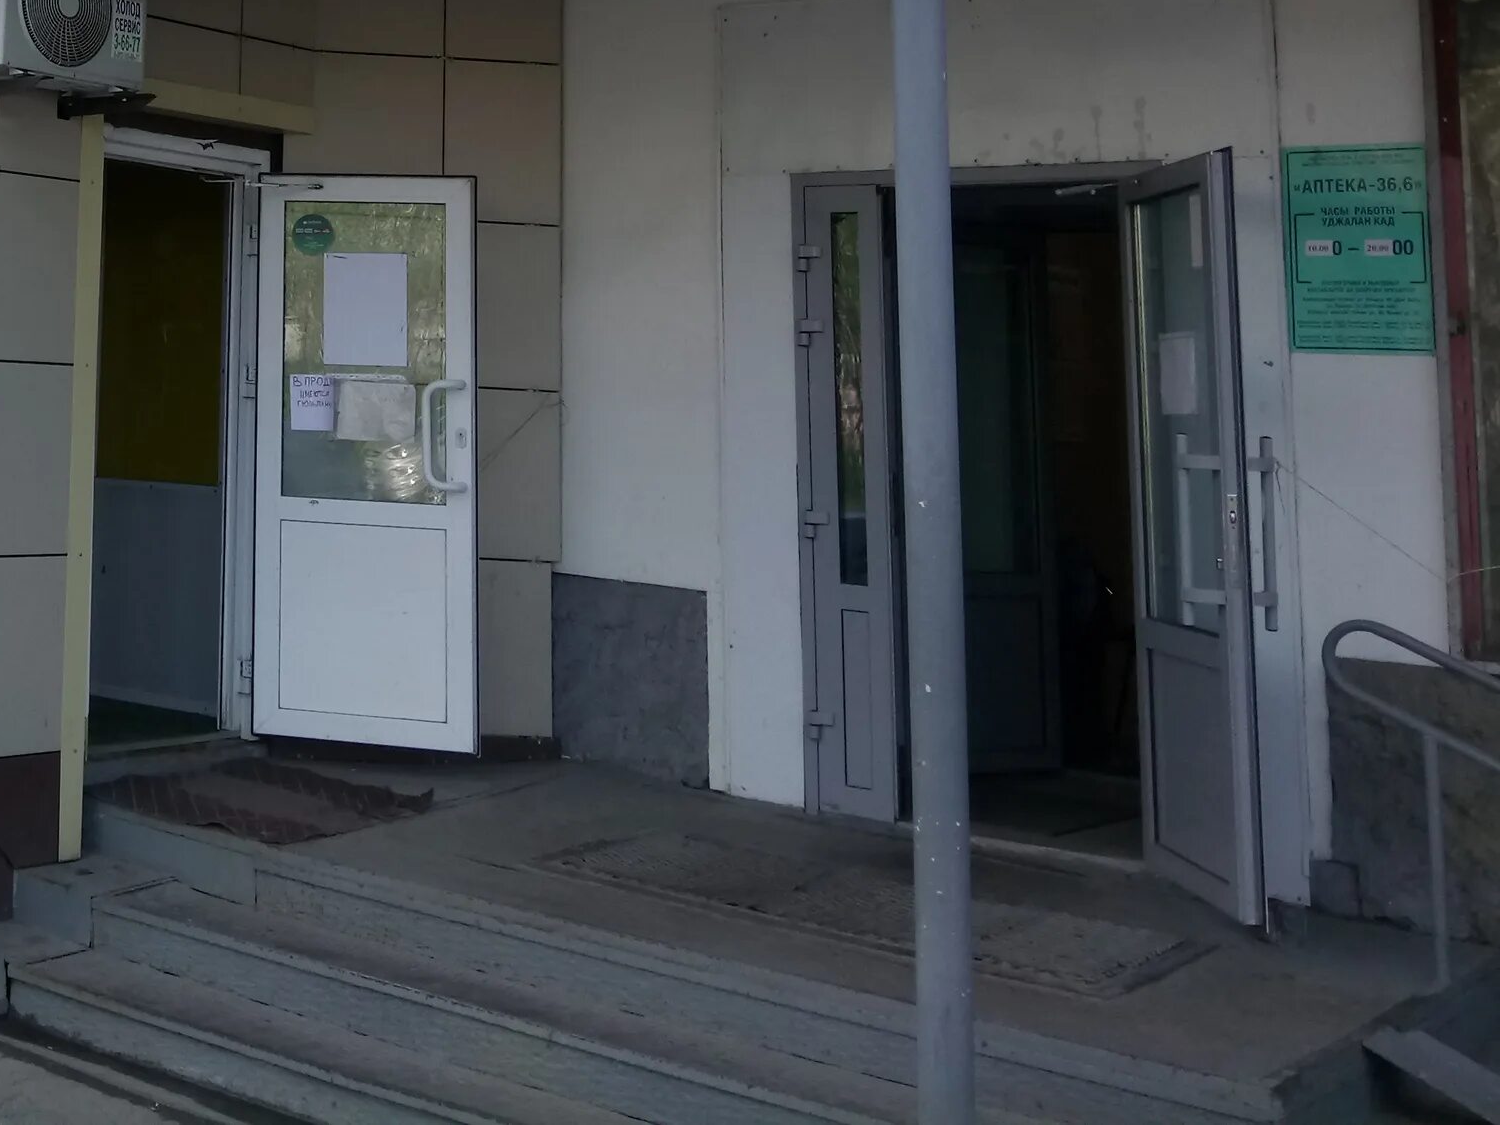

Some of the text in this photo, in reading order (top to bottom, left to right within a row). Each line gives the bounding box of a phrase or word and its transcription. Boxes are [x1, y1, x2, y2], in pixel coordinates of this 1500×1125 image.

[114, 17, 141, 35] СЕРВИС
[113, 33, 141, 53] 3-66-77
[1321, 206, 1396, 216] ЧАСЫ РАБОТЫ
[1322, 216, 1396, 227] УДЖАЛАН КАД
